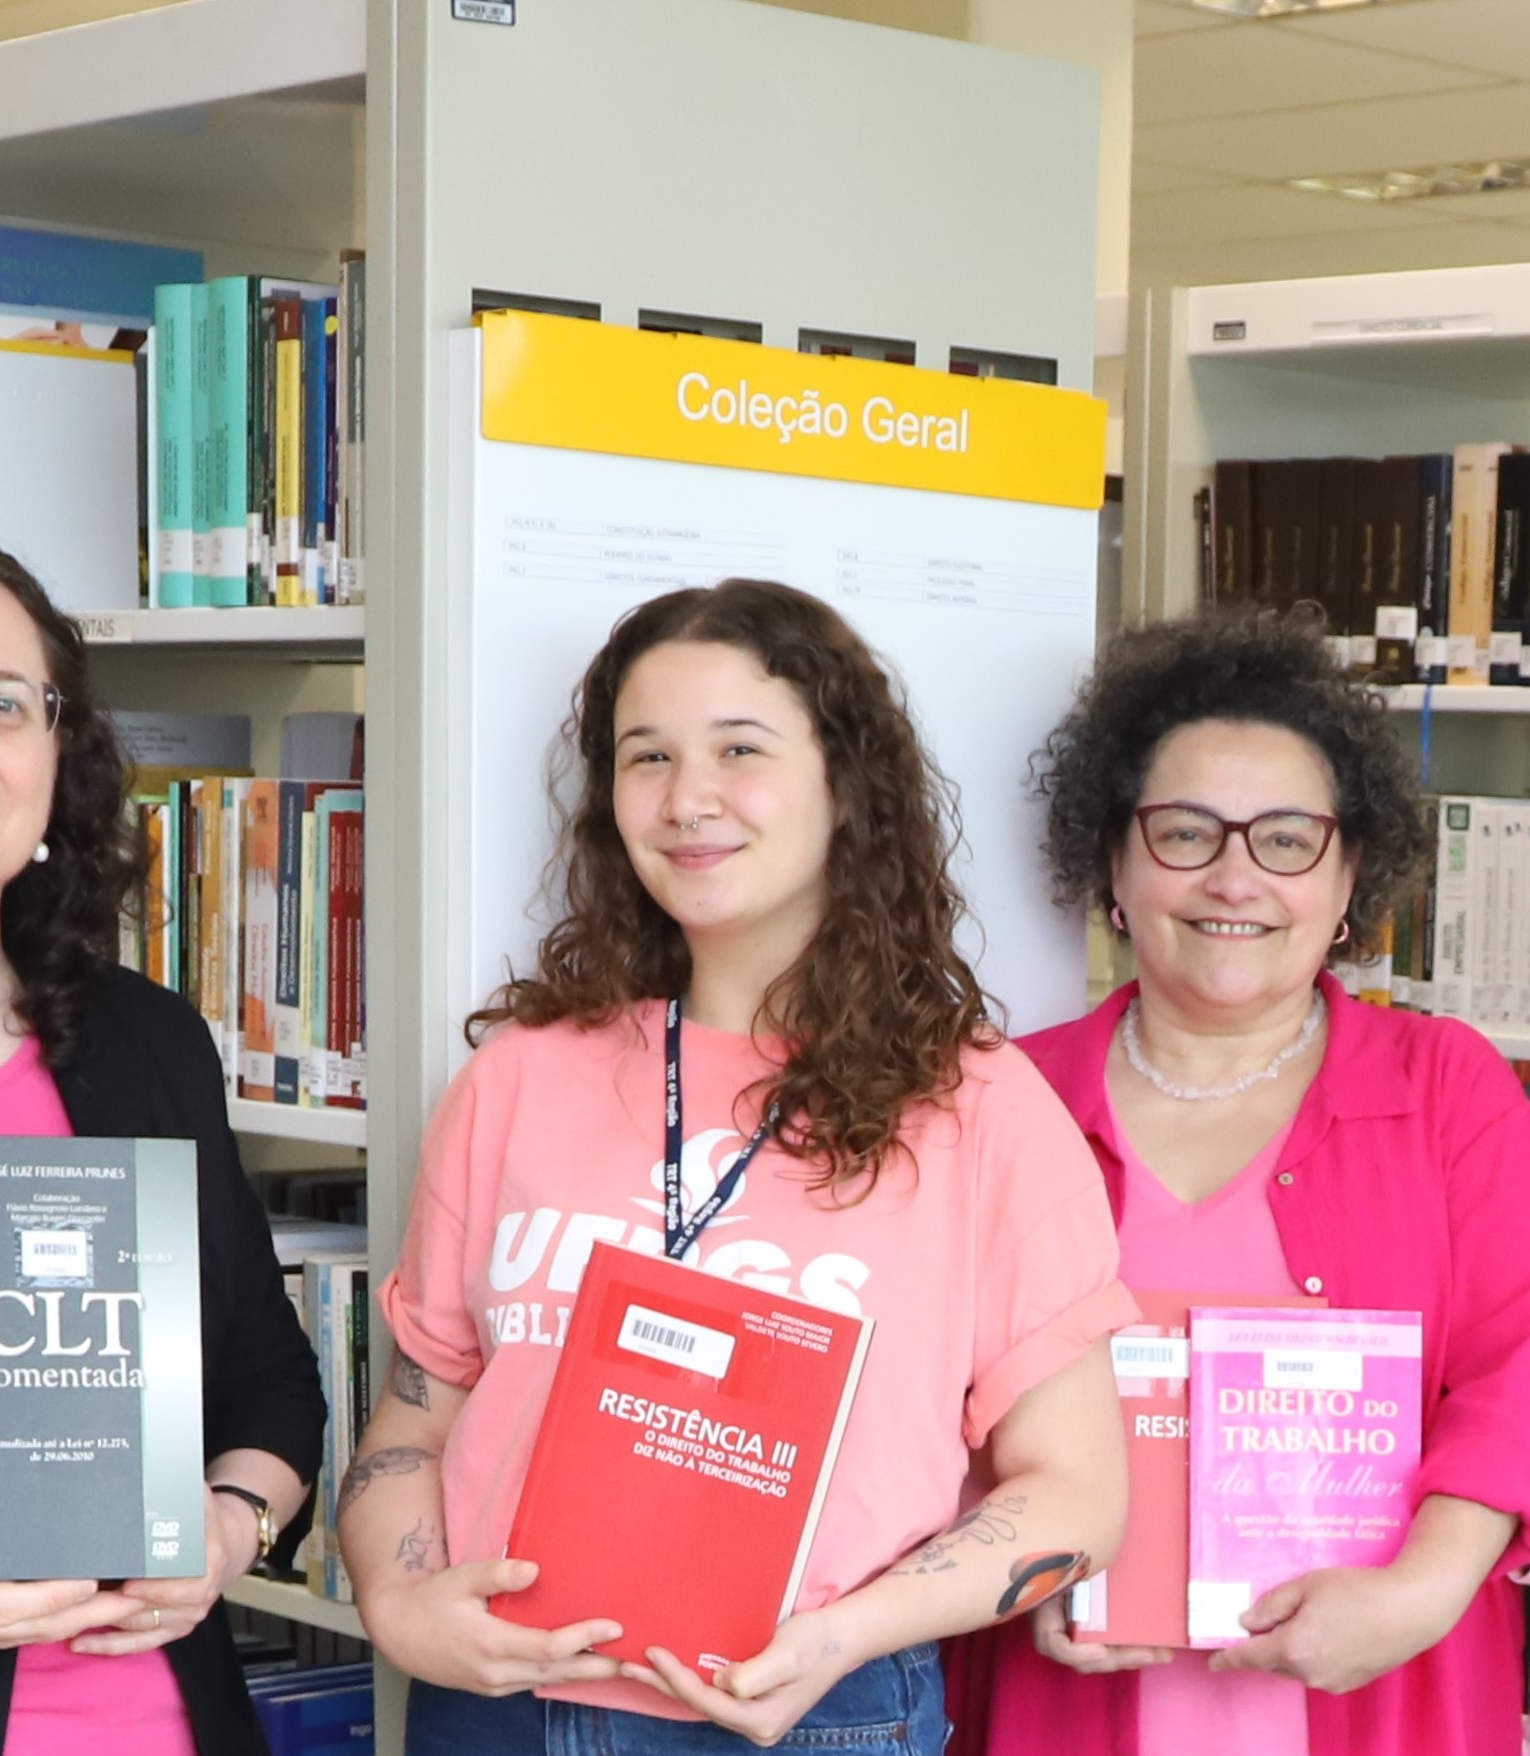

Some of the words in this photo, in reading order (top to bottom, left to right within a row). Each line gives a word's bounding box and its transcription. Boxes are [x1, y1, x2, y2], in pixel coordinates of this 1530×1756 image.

[677, 370, 847, 442] Coleção
[862, 397, 969, 453] Geral
[667, 1062, 676, 1080] TRT
[667, 1094, 677, 1127] Região
[11, 1166, 32, 1177] LUIZ
[35, 1166, 84, 1178] FERREIRA
[85, 1167, 126, 1179] PRUNES
[666, 1163, 678, 1182] TRT
[666, 1197, 678, 1231] Região
[670, 1236, 687, 1256] TRT
[693, 1196, 721, 1224] Região
[1219, 1388, 1354, 1418] DIREITO
[1364, 1401, 1398, 1418] DO
[597, 1387, 766, 1460] RESISTÊNCIA
[771, 1441, 797, 1469] III
[1221, 1426, 1395, 1455] TRABALHO
[30, 1451, 41, 1462] de
[44, 1438, 58, 1449] até
[59, 1440, 65, 1449] a
[67, 1438, 82, 1449] Lei
[644, 1431, 656, 1444] O
[657, 1434, 702, 1458] DIREITO
[705, 1446, 724, 1463] DO
[726, 1451, 791, 1484] TRABALHO
[633, 1442, 656, 1457] DIZ
[657, 1446, 682, 1466] NÃO
[696, 1460, 787, 1499] TERCEIRIZAÇÃO
[1213, 1464, 1255, 1496] da
[1271, 1460, 1403, 1498] Mulher
[152, 1521, 180, 1532] DVD
[152, 1541, 180, 1551] DVD
